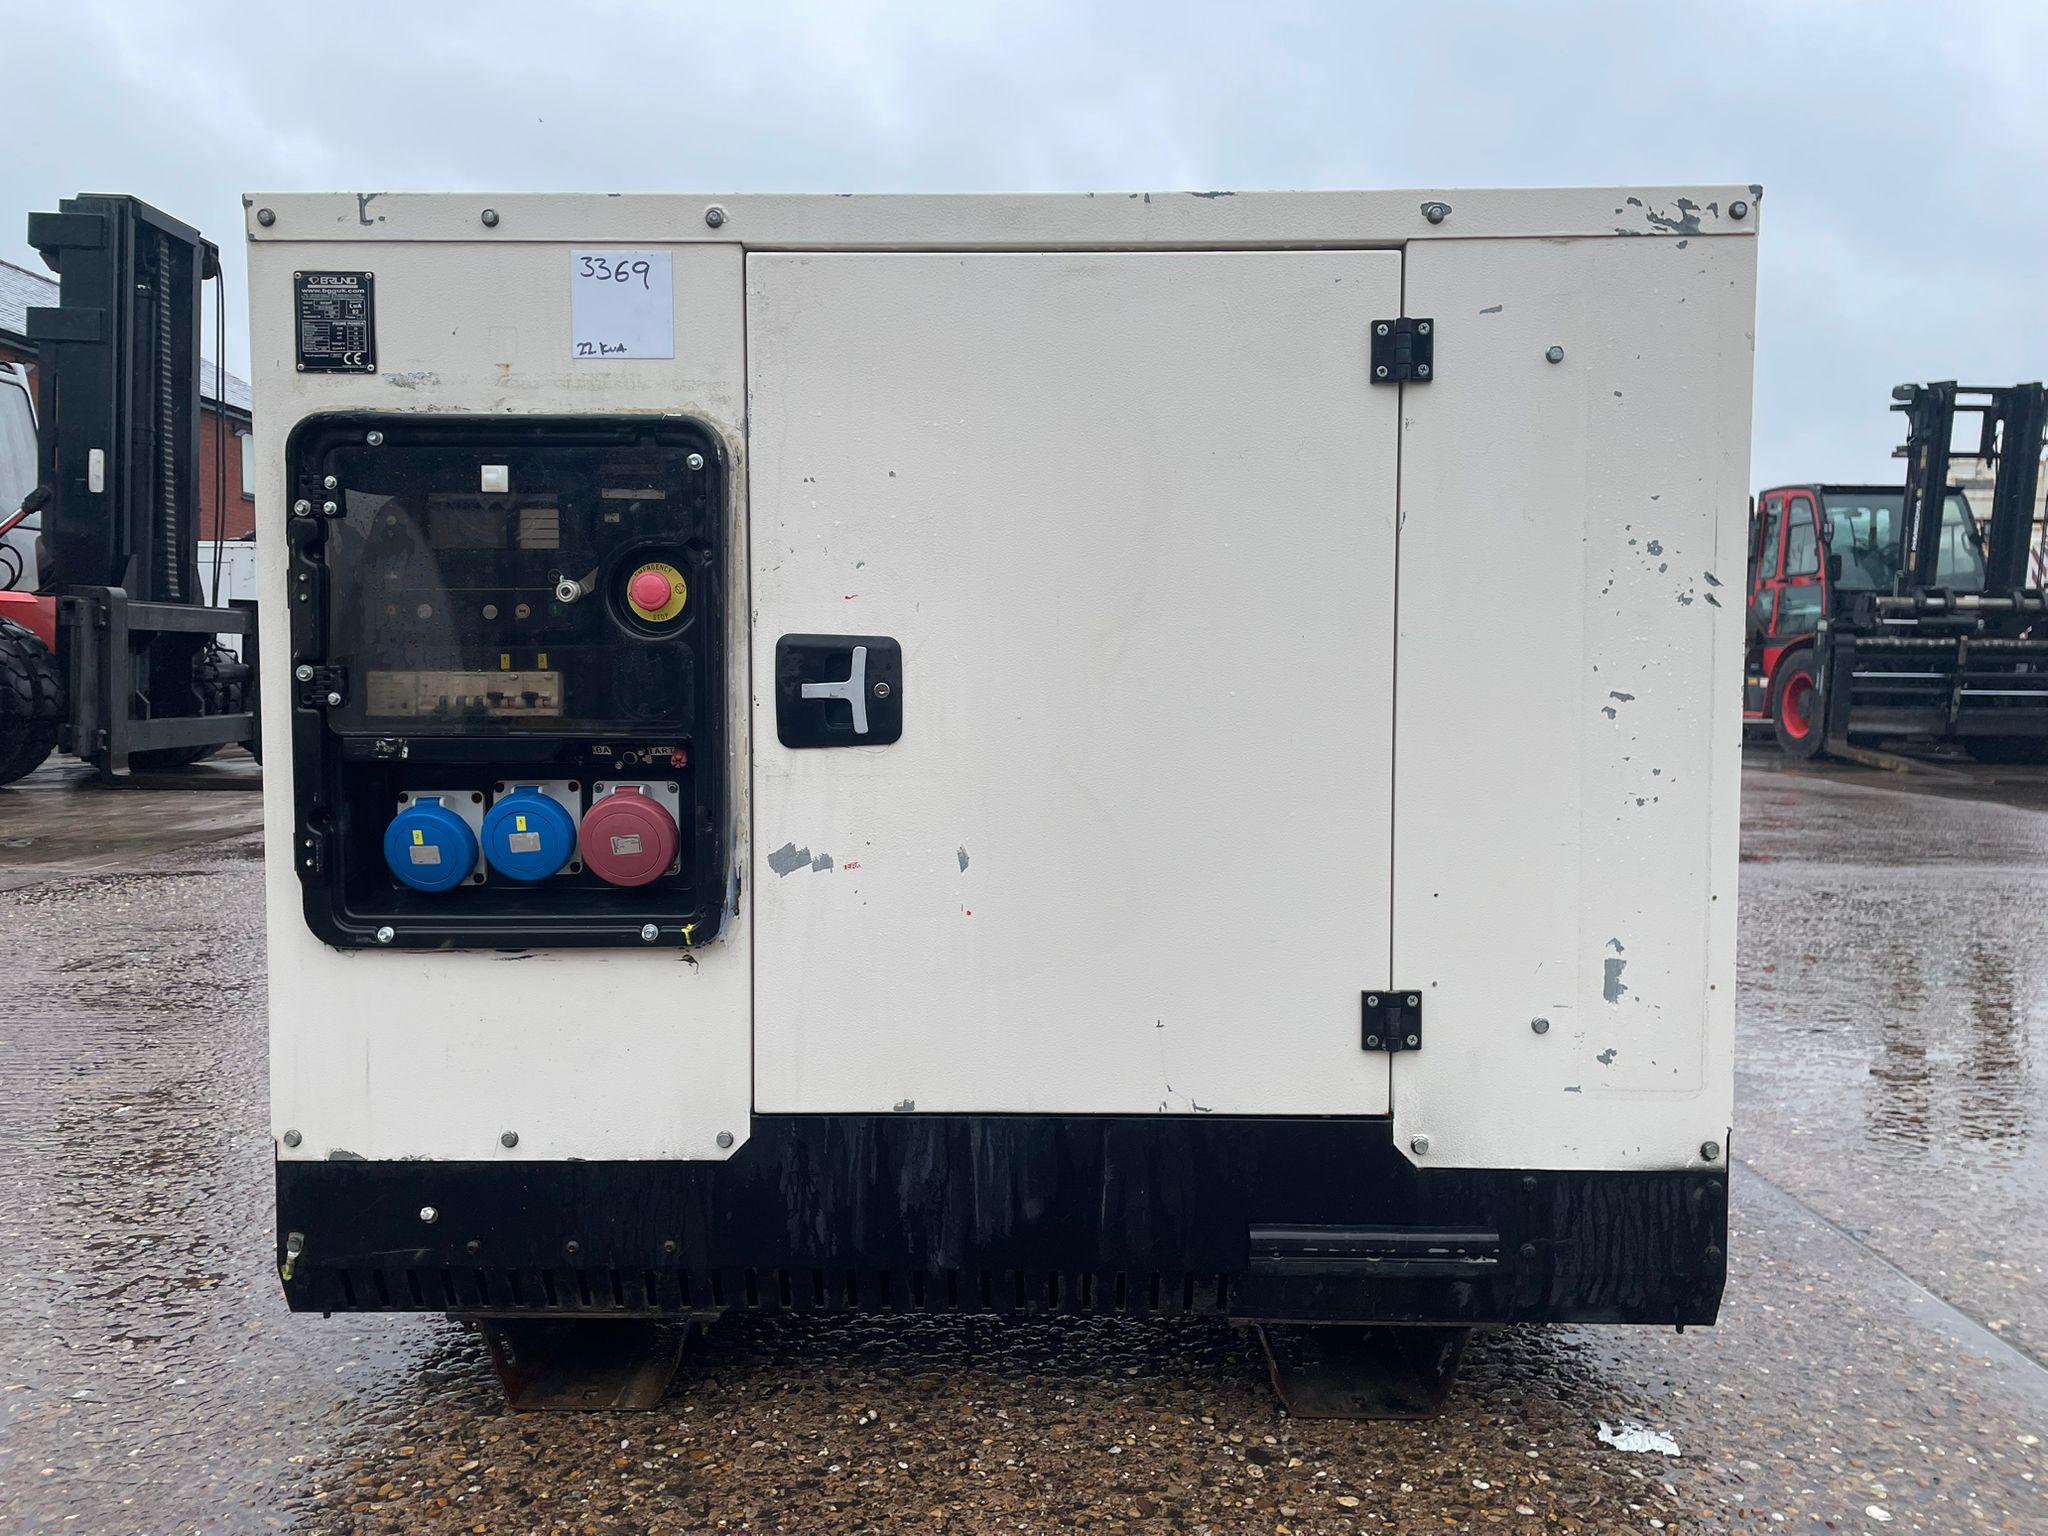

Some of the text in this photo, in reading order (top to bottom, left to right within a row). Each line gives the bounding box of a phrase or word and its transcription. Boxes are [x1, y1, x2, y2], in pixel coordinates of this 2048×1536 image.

[580, 256, 650, 290] 3369
[577, 342, 597, 355] 22
[344, 352, 362, 365] CE
